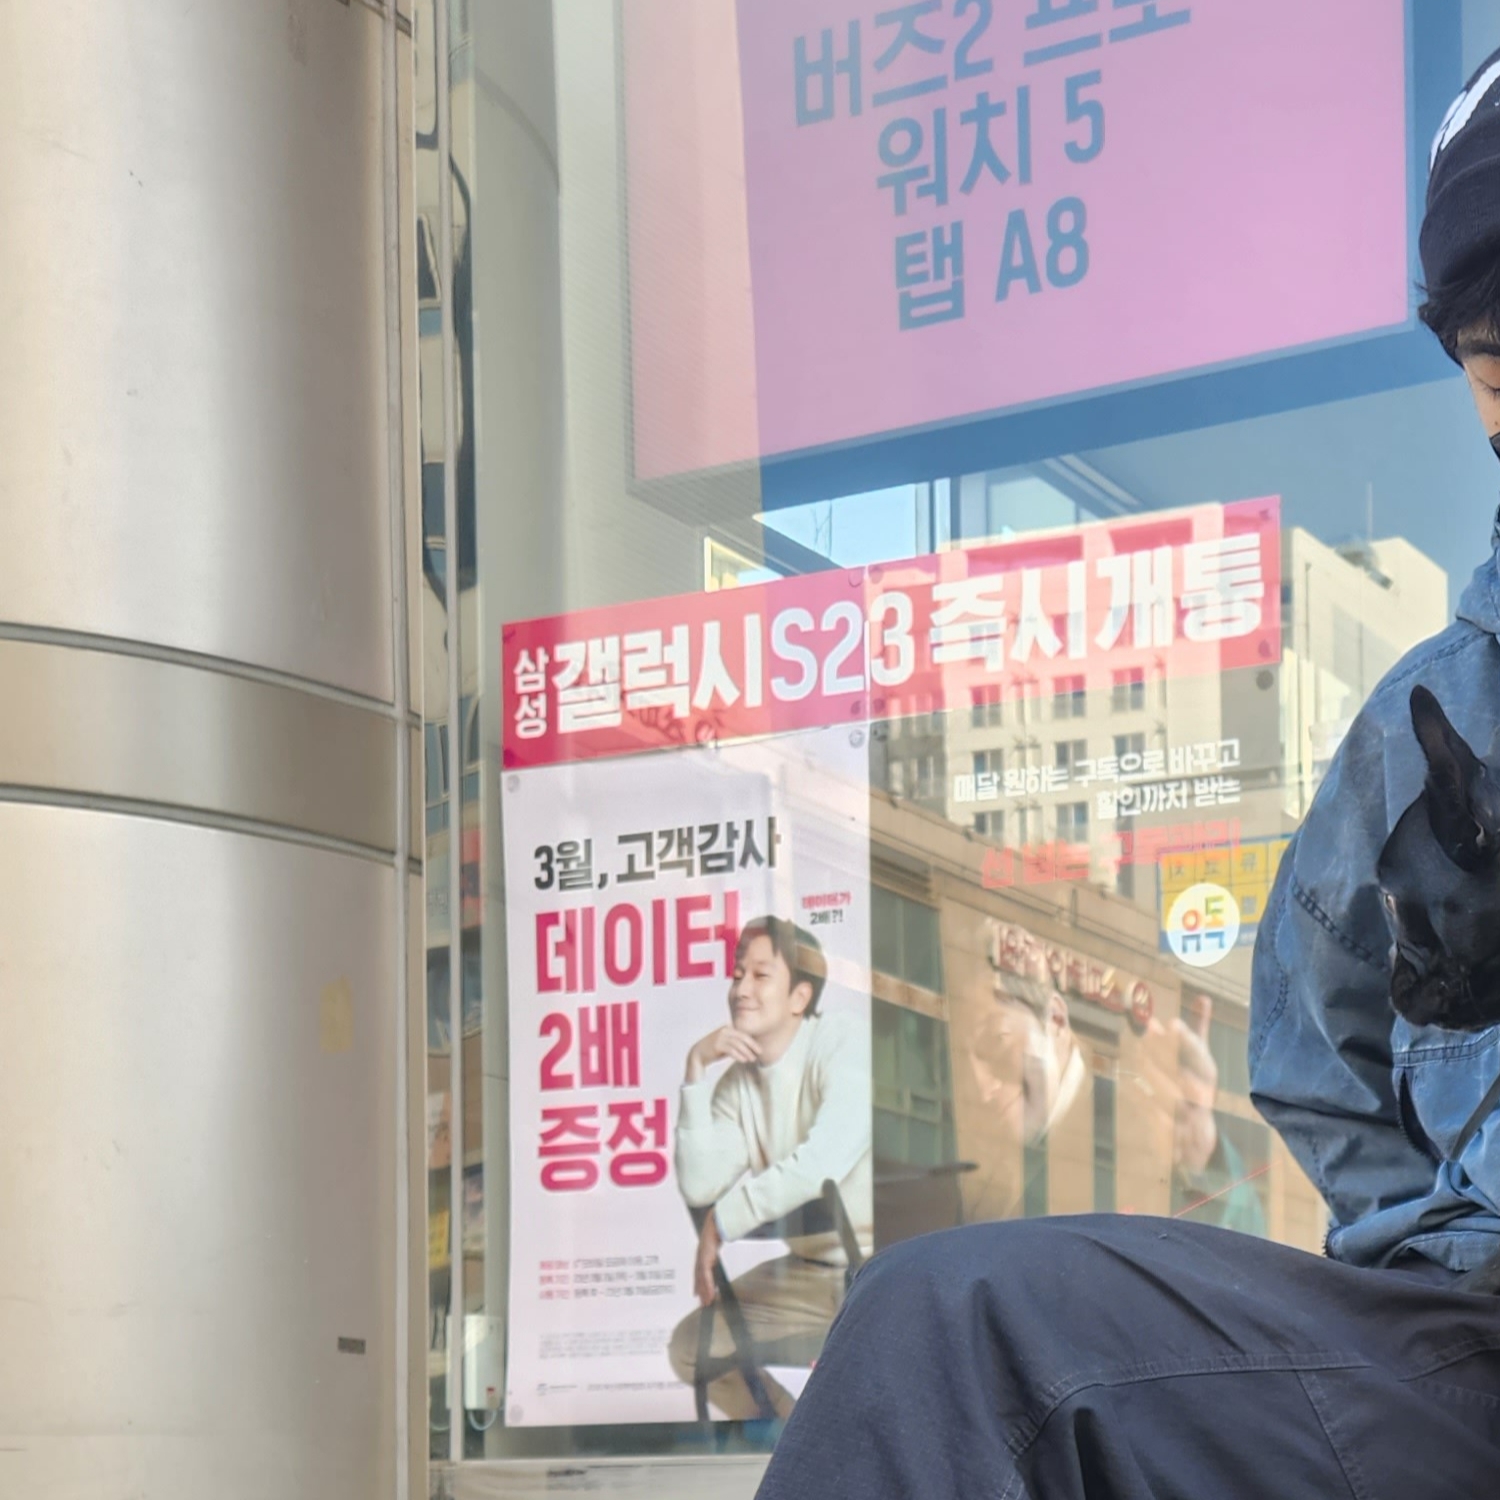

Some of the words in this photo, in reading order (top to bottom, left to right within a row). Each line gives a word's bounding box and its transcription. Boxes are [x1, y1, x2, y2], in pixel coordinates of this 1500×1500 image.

[793, 0, 994, 127] 버즈2
[876, 84, 1033, 217] 워치
[1062, 68, 1106, 164] 5
[894, 220, 966, 331] 탭
[995, 196, 1090, 304] A8
[513, 646, 549, 739] 삼성
[929, 532, 1265, 673] 즉시개통
[1003, 764, 1069, 798] 원하는
[1073, 749, 1166, 789] 구독으로
[1168, 738, 1241, 775] 바꾸고
[535, 889, 741, 995] 데이터
[538, 1000, 641, 1092] 2배
[537, 1097, 669, 1192] 증정
